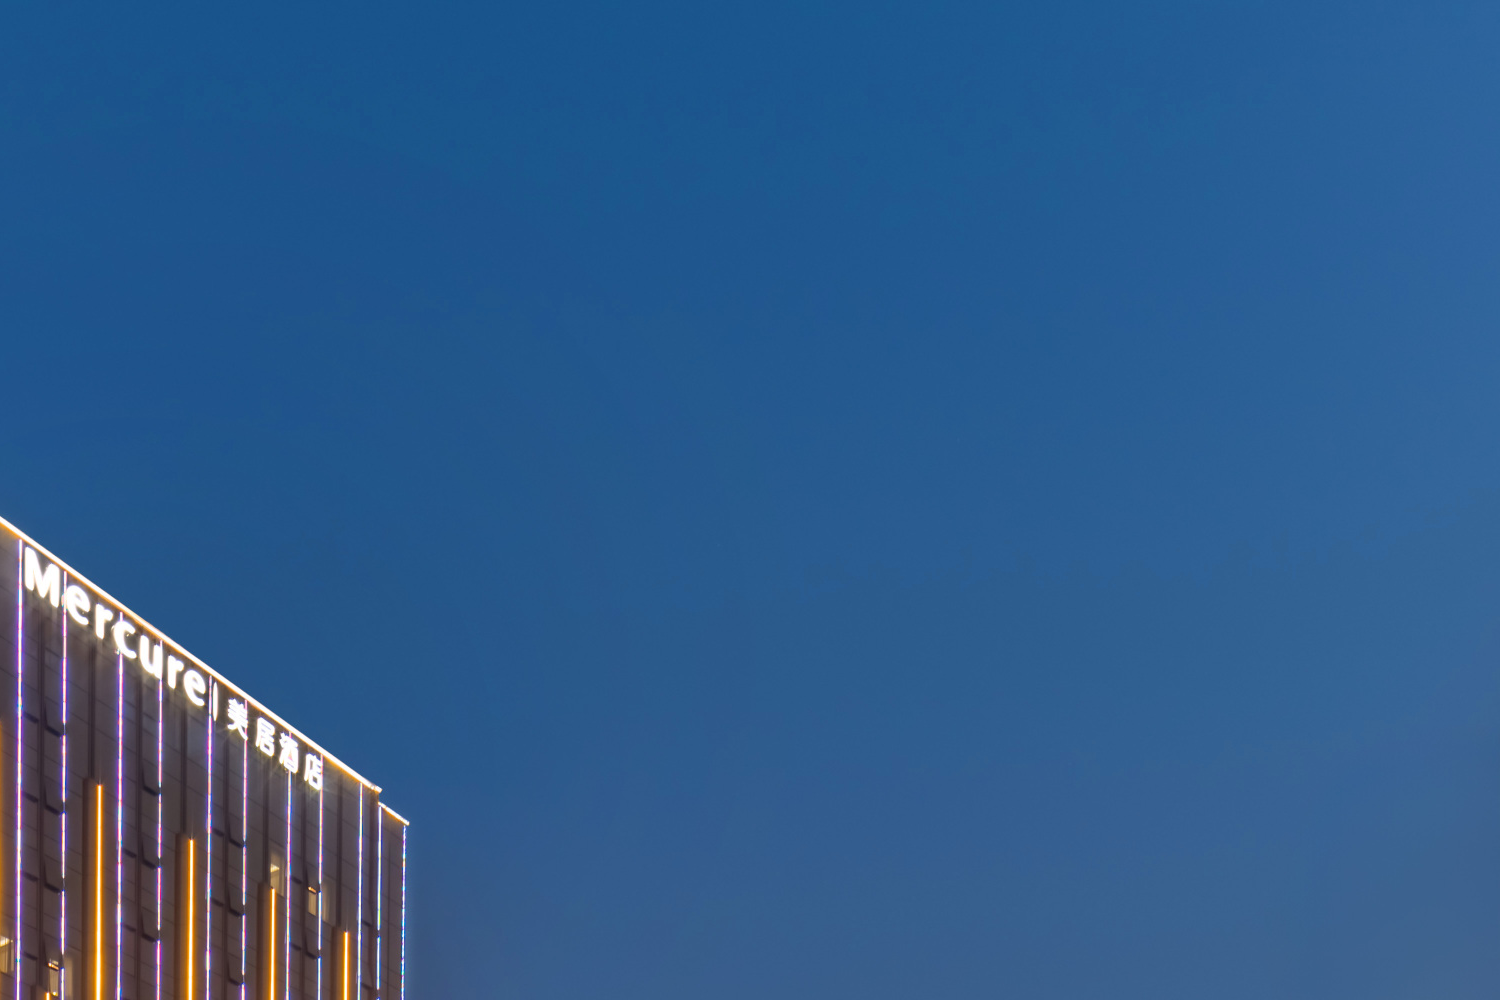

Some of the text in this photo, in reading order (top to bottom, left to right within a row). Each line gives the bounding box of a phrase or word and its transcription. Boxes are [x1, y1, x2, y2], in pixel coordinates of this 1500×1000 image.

[24, 546, 324, 790] Mercure 美居酒店
